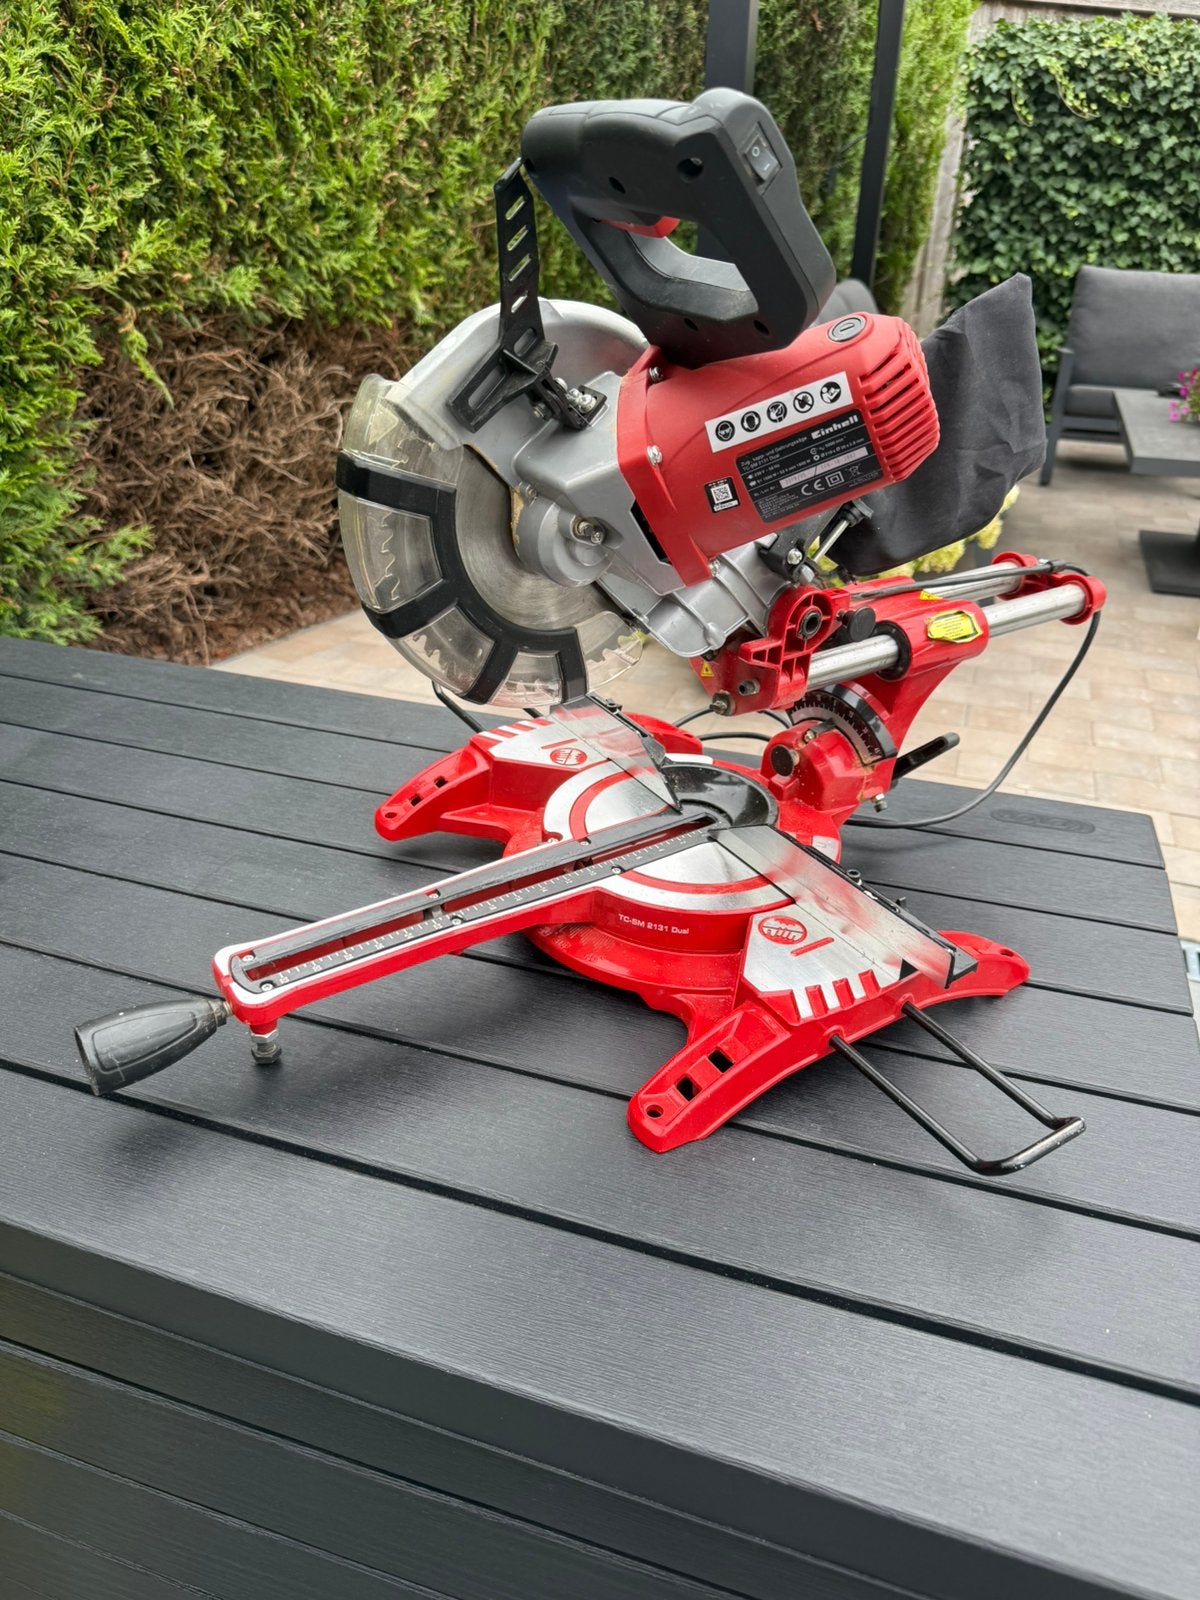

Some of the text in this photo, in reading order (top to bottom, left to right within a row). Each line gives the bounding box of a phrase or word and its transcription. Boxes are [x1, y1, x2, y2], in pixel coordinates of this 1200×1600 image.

[811, 415, 859, 440] Einhell
[768, 452, 780, 461] Dual
[618, 913, 690, 935] TC-SM 2131 Dual
